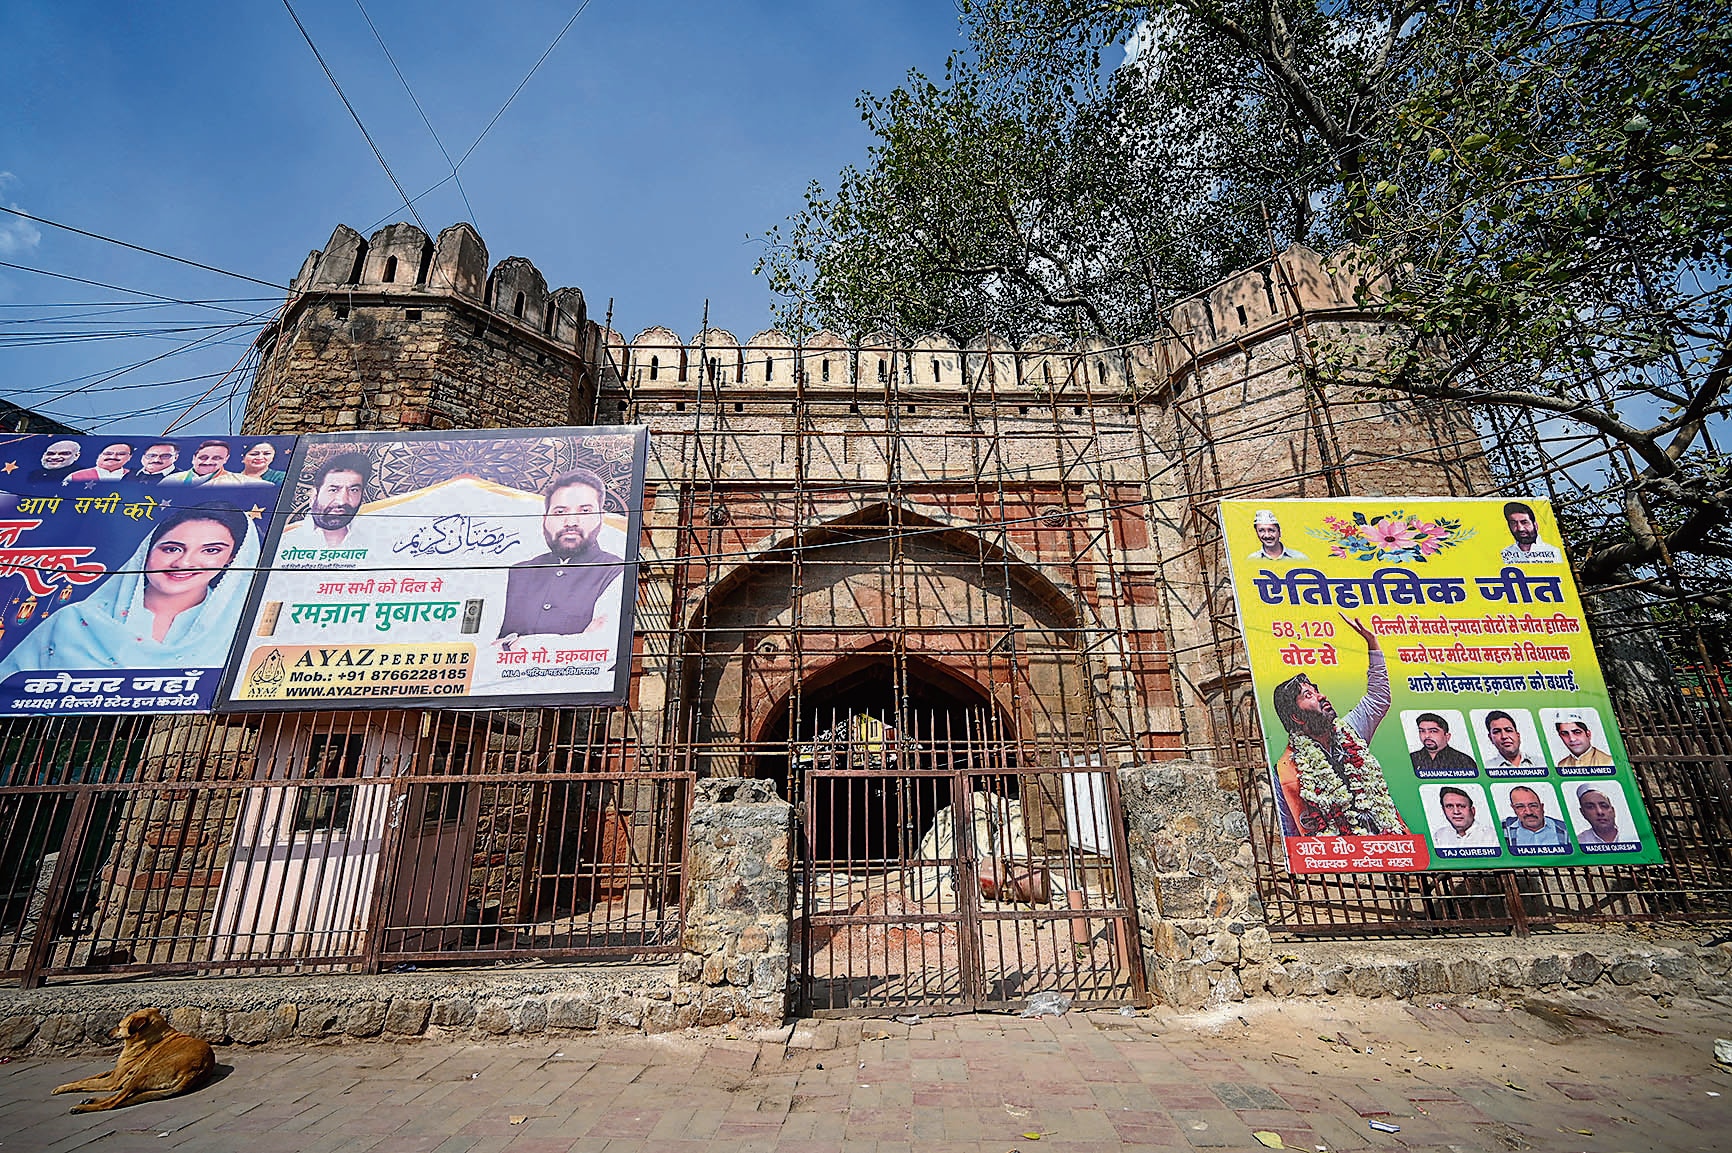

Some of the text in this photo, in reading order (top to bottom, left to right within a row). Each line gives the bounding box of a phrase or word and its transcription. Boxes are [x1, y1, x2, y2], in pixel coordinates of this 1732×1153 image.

[17, 492, 157, 521] आप सभी को
[281, 546, 368, 561] शोएब इक़बाल
[317, 577, 443, 595] आप सभी को दिल से
[1253, 566, 1565, 608] ऐतिहासिक जीत
[291, 601, 460, 631] रमज़ान मुबारक
[1372, 615, 1408, 635] दिल्ली
[1409, 615, 1419, 634] में
[1419, 615, 1450, 634] सबसे
[1482, 615, 1506, 634] वोटों
[1507, 615, 1520, 634] से
[1520, 614, 1546, 633] जीत
[1545, 613, 1579, 633] हासिल
[1272, 621, 1335, 640] 58,120
[295, 648, 470, 667] AYAZ PERFUME
[497, 647, 609, 664] आले मो. इक़बाल
[1280, 643, 1338, 665] वोट से
[1398, 641, 1570, 664] करने पर मटिया महल से विधायक
[24, 670, 204, 694] कौसर जहाँ
[289, 669, 467, 682] Mob.: +91 8766228185
[502, 669, 520, 678] MLA
[1408, 672, 1434, 691] आले
[1434, 672, 1483, 693] मोहम्मद
[1528, 671, 1548, 691] को
[1548, 670, 1580, 692] बधाई.
[286, 685, 465, 697] WWW.AYAZPERFUME.COM
[11, 693, 200, 709] अध्यक्ष दिल्ली स्टेट हज कमेटी
[1296, 837, 1327, 855] आले
[1361, 840, 1416, 855] इकबाल
[1443, 847, 1496, 857] TAJ QURESHI
[1517, 846, 1566, 855] HAJI ASLAM
[1585, 843, 1637, 852] NADEEM QURESHI
[1304, 856, 1415, 869] विधायक मटीया महल
